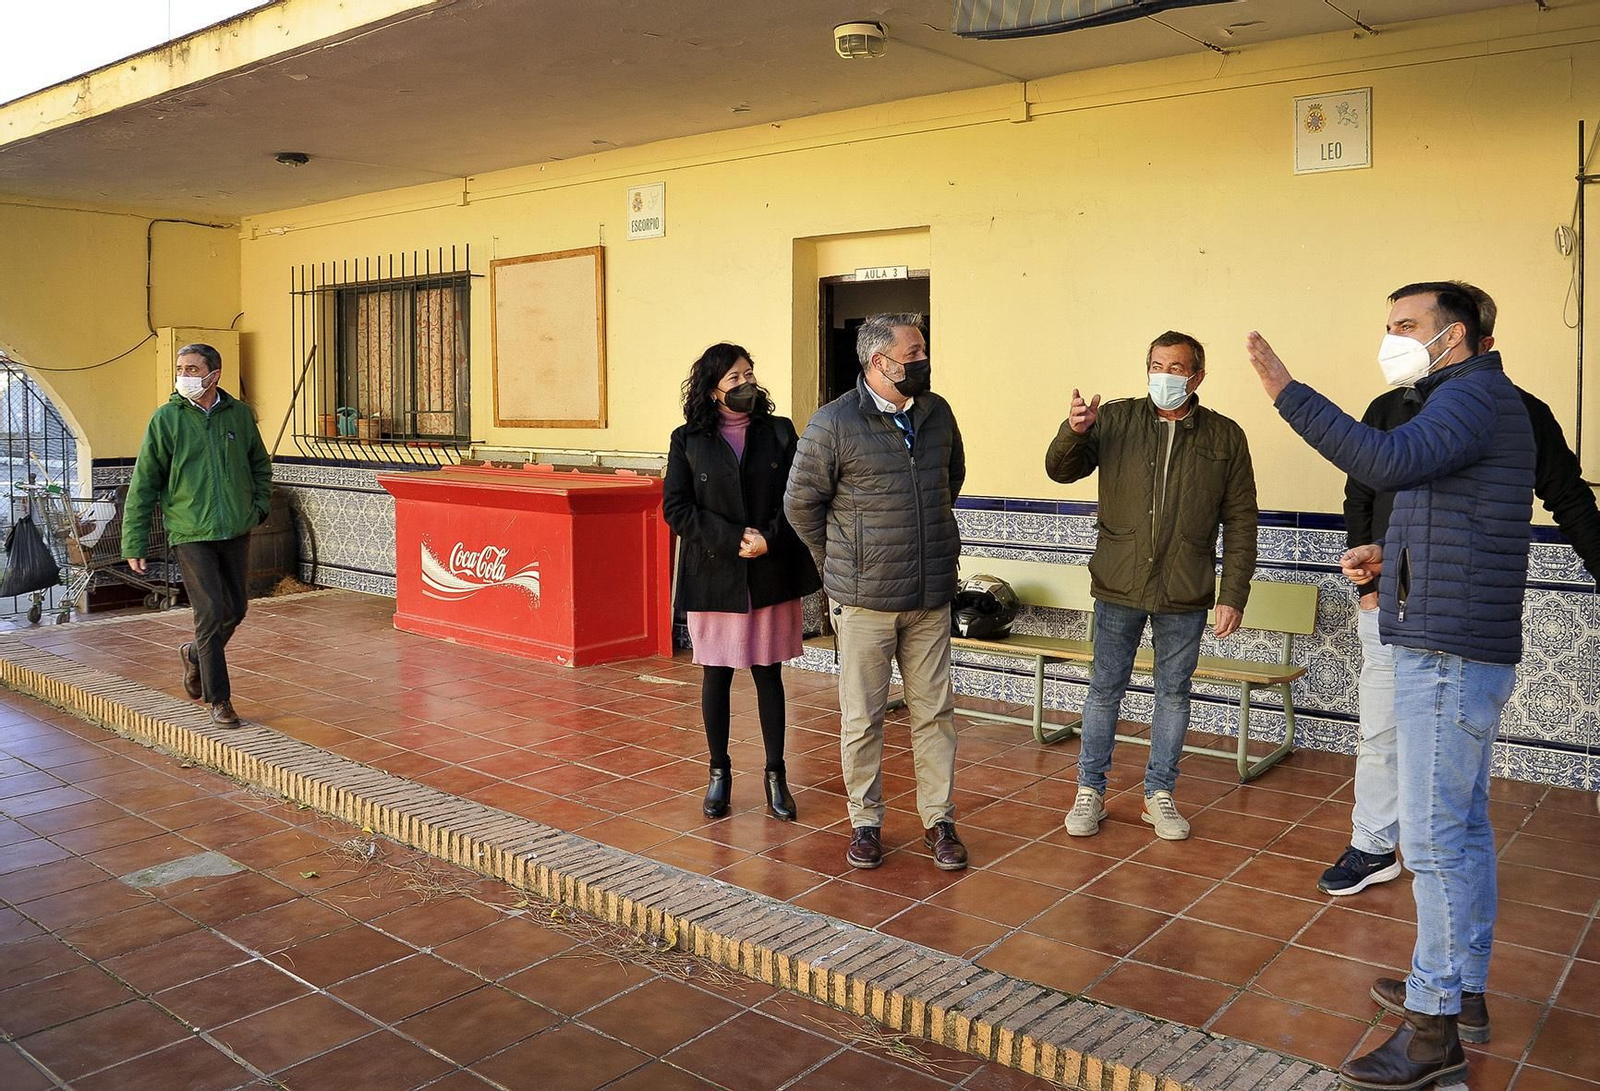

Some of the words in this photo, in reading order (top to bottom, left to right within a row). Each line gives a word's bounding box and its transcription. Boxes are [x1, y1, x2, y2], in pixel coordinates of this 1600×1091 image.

[1320, 141, 1342, 161] LEO
[631, 216, 660, 233] ESCORPIO
[864, 269, 887, 280] AULA
[892, 268, 898, 278] 3
[449, 541, 510, 581] Coca-Cola
